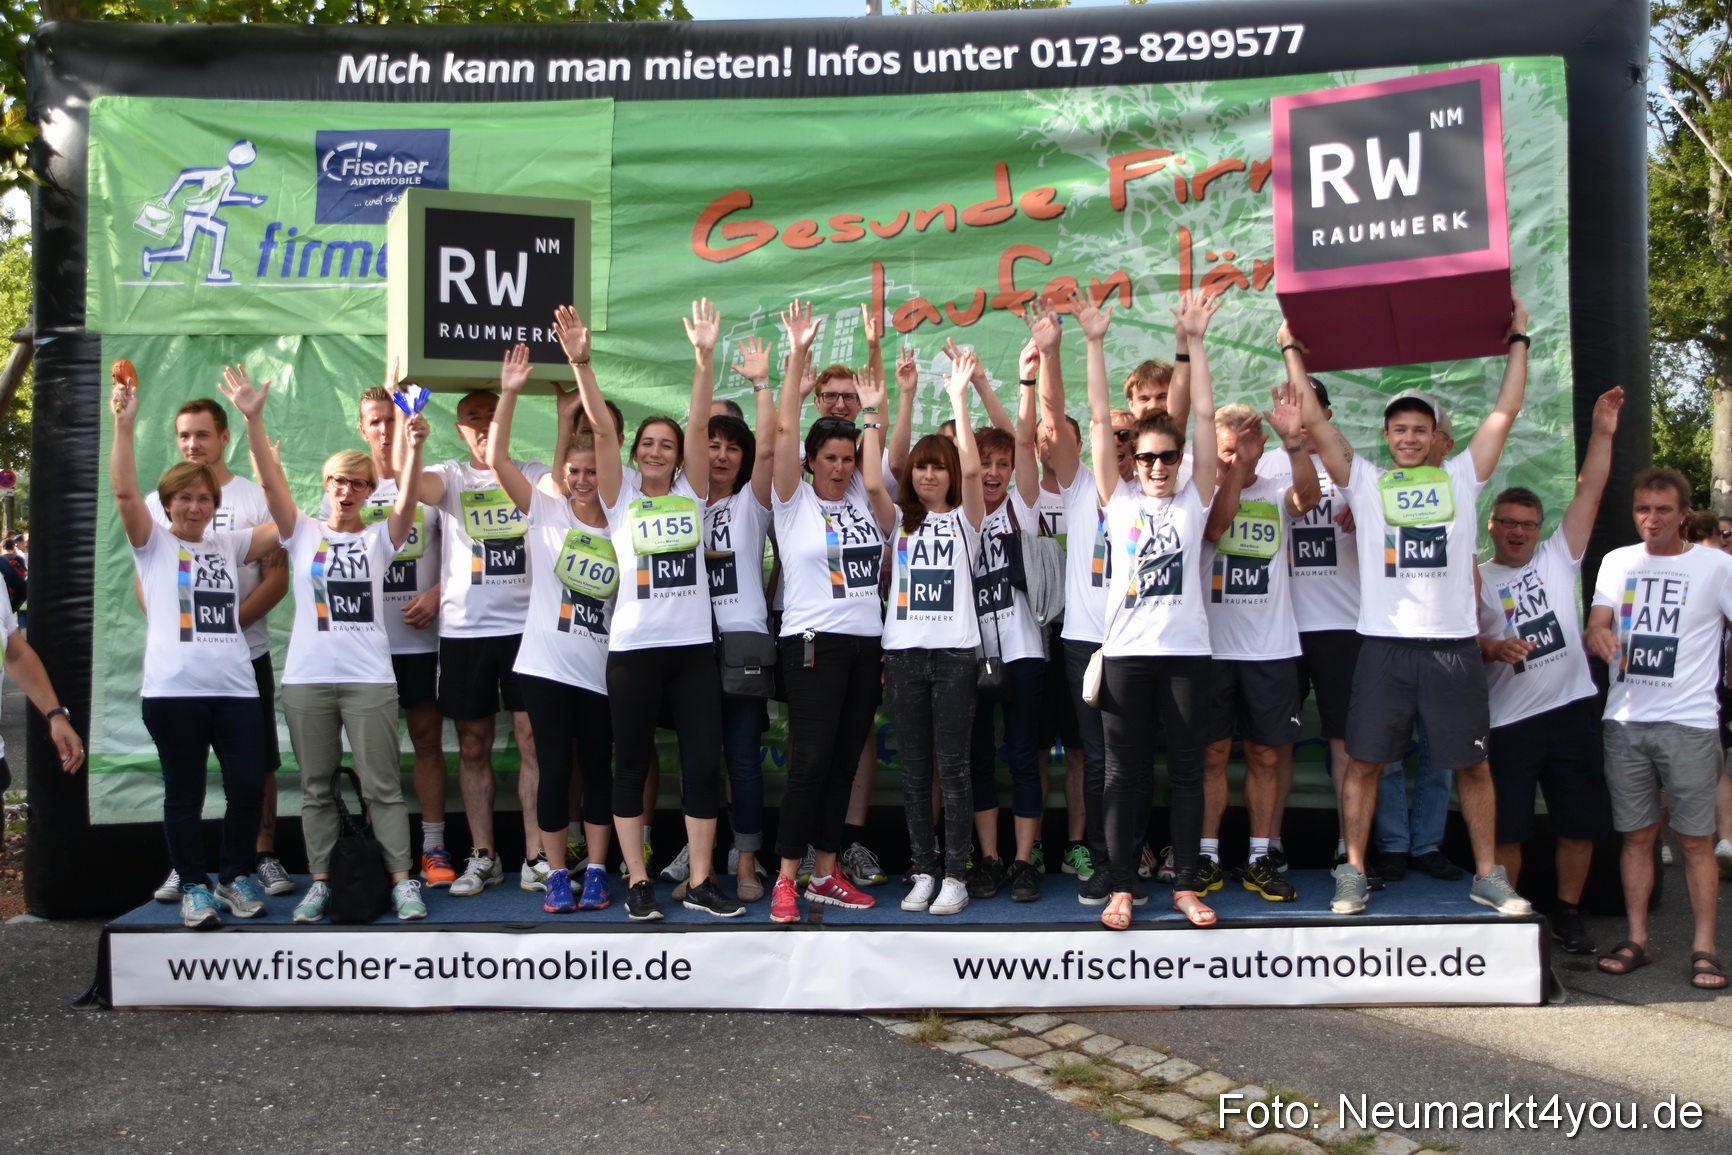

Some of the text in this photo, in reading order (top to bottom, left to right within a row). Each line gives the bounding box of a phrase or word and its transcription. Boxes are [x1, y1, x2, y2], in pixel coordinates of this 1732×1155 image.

[338, 24, 1305, 84] Mich kann man mieten! Infos unter 0173-8299577
[342, 157, 429, 176] Fischer
[1308, 107, 1465, 209] RW NM
[350, 177, 421, 186] AUTOMOBILE
[691, 161, 1066, 263] Gesunde
[1312, 210, 1470, 247] RAUMWERK
[440, 238, 560, 307] RW NM
[871, 243, 1133, 338] laufen
[439, 322, 558, 343] RAUMWERK
[1397, 488, 1440, 510] 524
[470, 507, 523, 526] 1154
[638, 516, 693, 538] 1155
[1229, 520, 1275, 543] 1159
[490, 550, 516, 567] RW
[911, 539, 954, 566] AM
[1298, 541, 1325, 558] RW
[1404, 540, 1435, 559] RW
[327, 554, 370, 579] AM
[566, 553, 616, 585] 1160
[657, 558, 686, 578] RW
[847, 560, 873, 579] RW
[1231, 567, 1259, 586] RW
[1400, 570, 1448, 579] RAUMWERK
[486, 578, 527, 586] RAUMWERK
[1143, 567, 1170, 590] RW
[653, 589, 698, 599] RAUMWERK
[914, 583, 942, 602] RW
[1225, 597, 1268, 605] RAUMWERK
[1641, 577, 1682, 605] TE
[199, 605, 226, 625] RW
[333, 595, 362, 614] RW
[575, 603, 599, 624] RW
[1514, 587, 1549, 624] AM
[1632, 605, 1681, 634] AM
[1527, 650, 1569, 671] RAUMWERK
[1632, 645, 1675, 668] RW NM
[1625, 677, 1673, 688] RAUMWERK
[168, 950, 693, 982] www.fischer-automobile.de
[952, 946, 1487, 981] www.fischer-automobile.de
